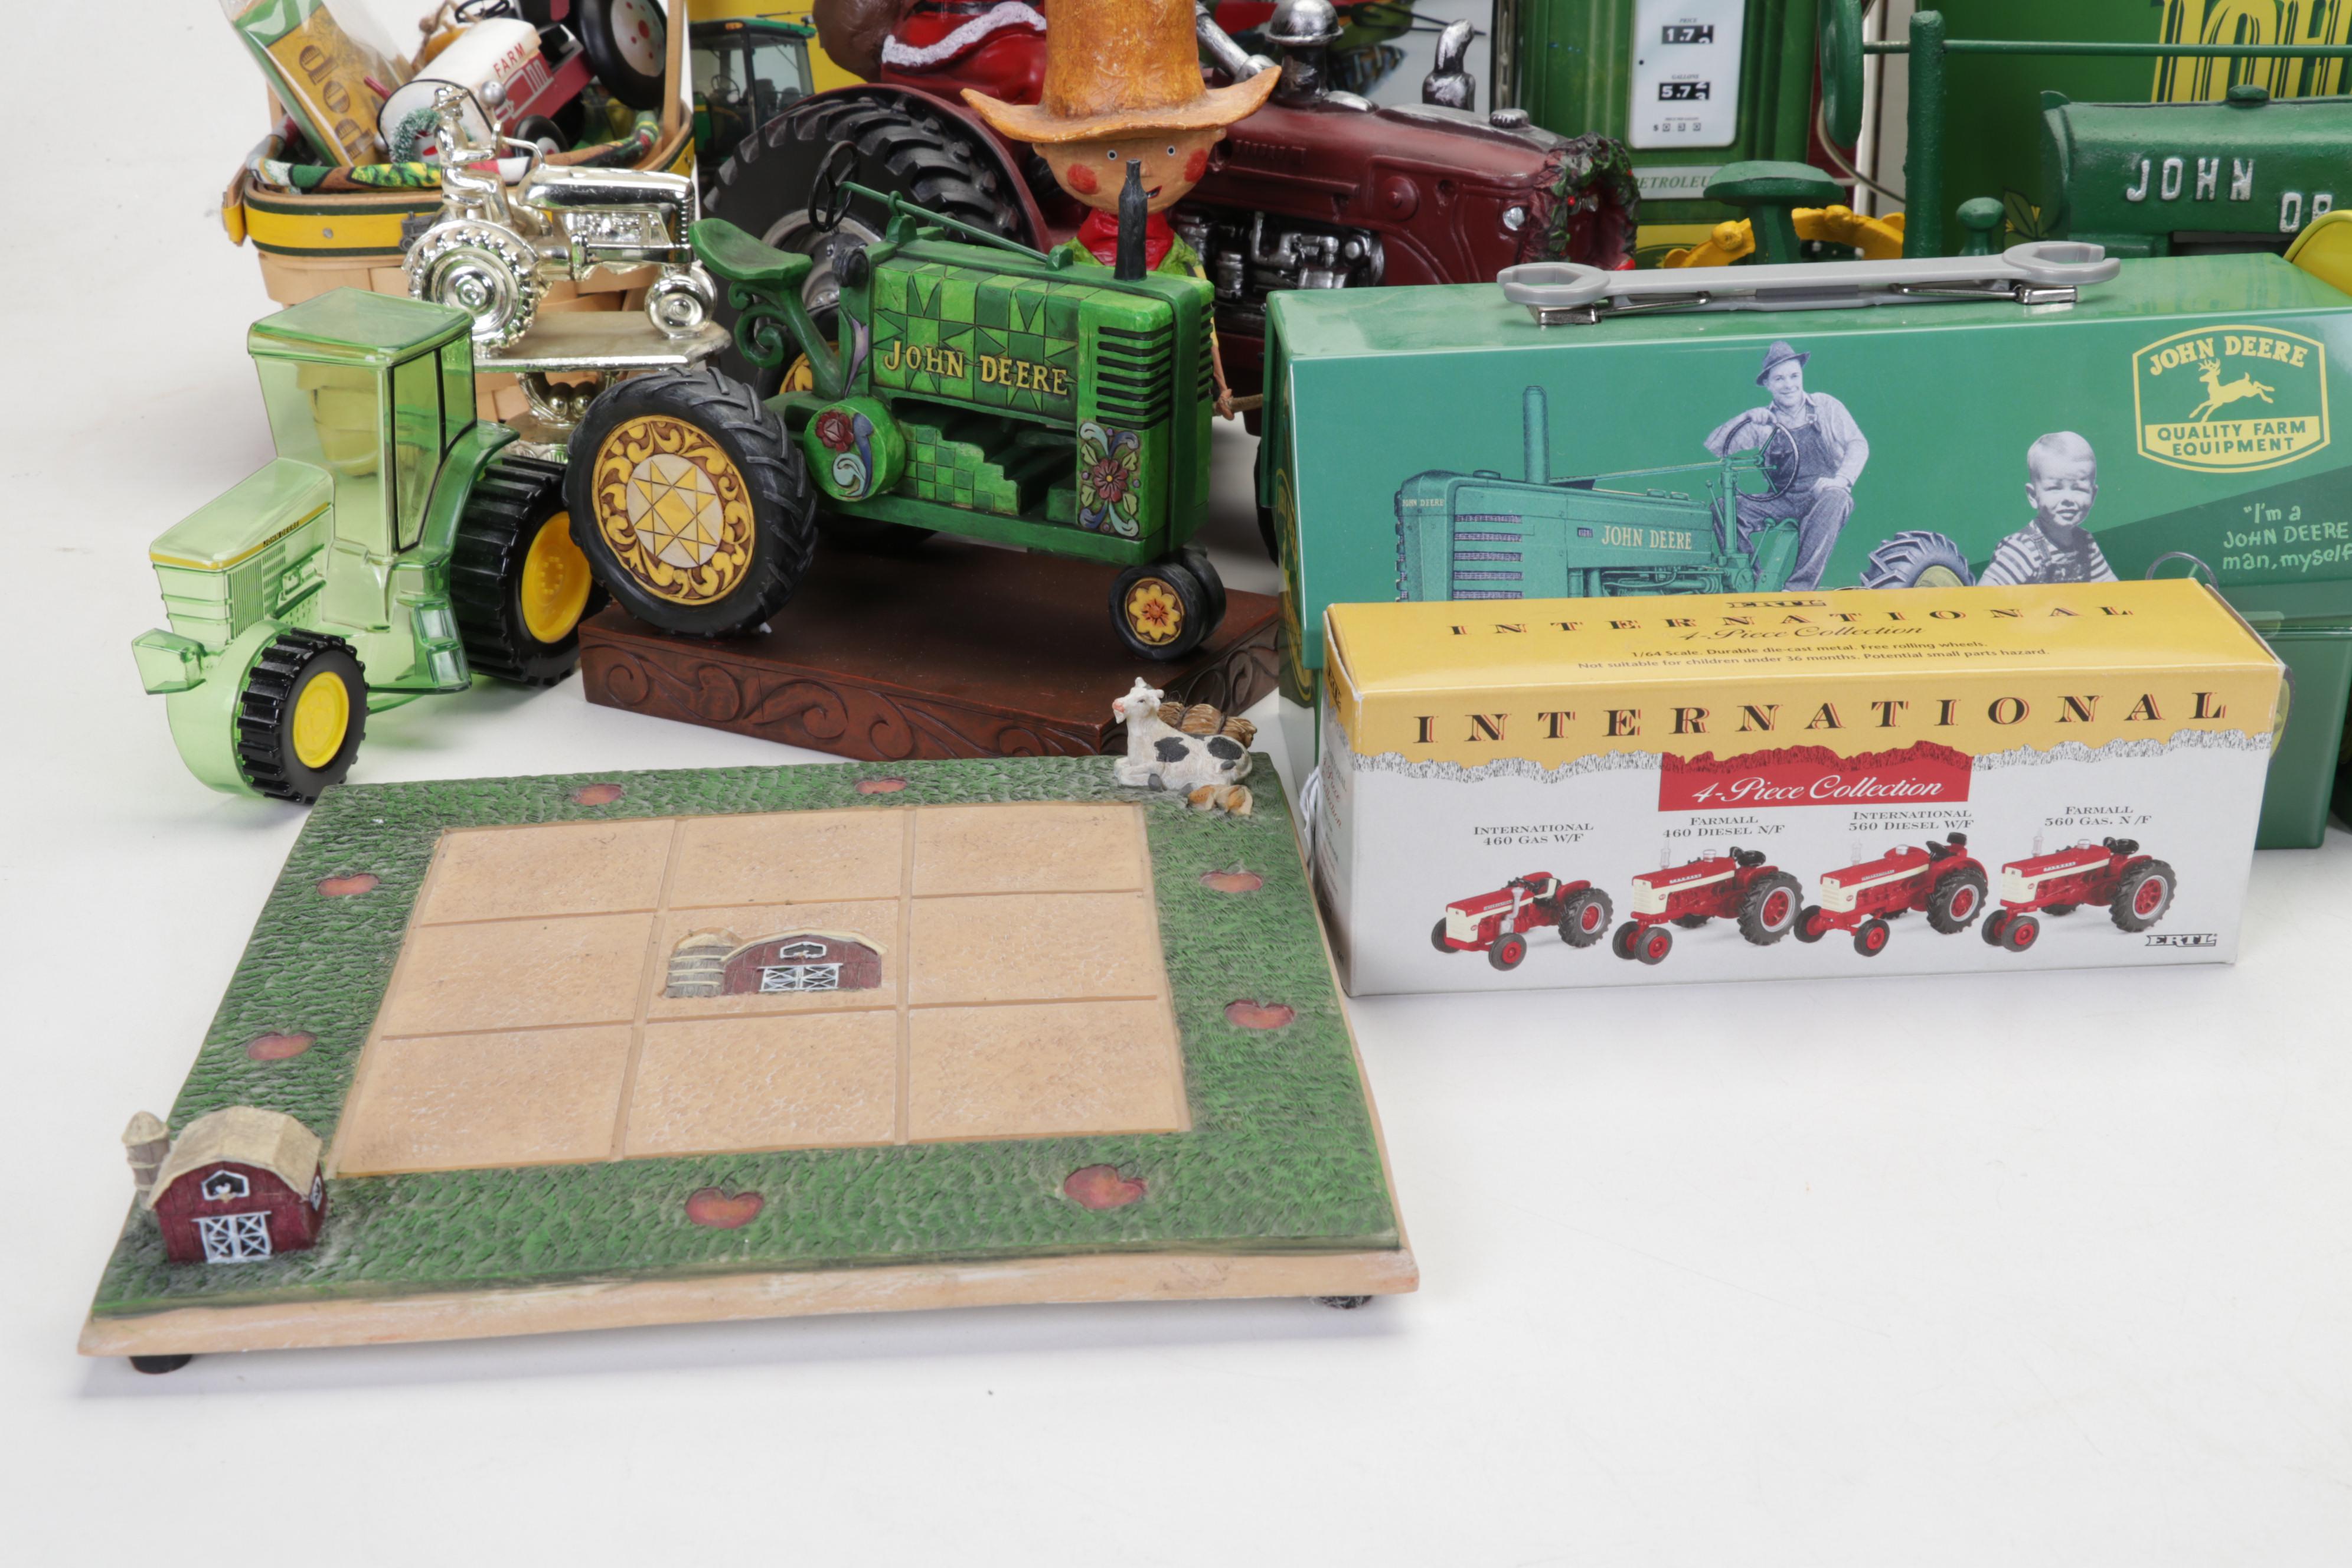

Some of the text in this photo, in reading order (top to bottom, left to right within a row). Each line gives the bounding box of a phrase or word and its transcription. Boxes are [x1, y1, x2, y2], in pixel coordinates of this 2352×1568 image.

[494, 43, 525, 79] FARM
[1636, 175, 1711, 189] ETROLEU
[2126, 158, 2254, 201] JOHN
[2150, 336, 2308, 375] JOHN DEERE
[884, 340, 1068, 395] JOHN DEERE
[2157, 420, 2306, 441] QUALITY FARM
[2173, 437, 2294, 456] EQUIPMENT
[2289, 505, 2301, 521] a
[1601, 525, 1692, 550] JOHN DEERE
[2223, 522, 2349, 548] JOHN DEERE
[2222, 553, 2278, 570] man,
[1726, 599, 1827, 609] ERTL
[1679, 626, 1925, 641] 4-Piece Collection
[1413, 691, 2226, 744] INTERNATIONAL
[1692, 775, 1945, 803] 4-Piece Collection
[1852, 810, 1972, 820] INTERNATIONAL
[2066, 806, 2134, 815] FARMALL
[1690, 816, 1758, 826] FARMALL
[1848, 819, 1974, 831] 560 DIESEL W/F
[2044, 818, 2074, 827] 560
[1474, 823, 1594, 835] INTERNATIONAL
[1662, 825, 1785, 838] 460 DIESEL N/F
[1483, 833, 1584, 845] 460 GAS W/F
[2144, 933, 2218, 948] ERTL
